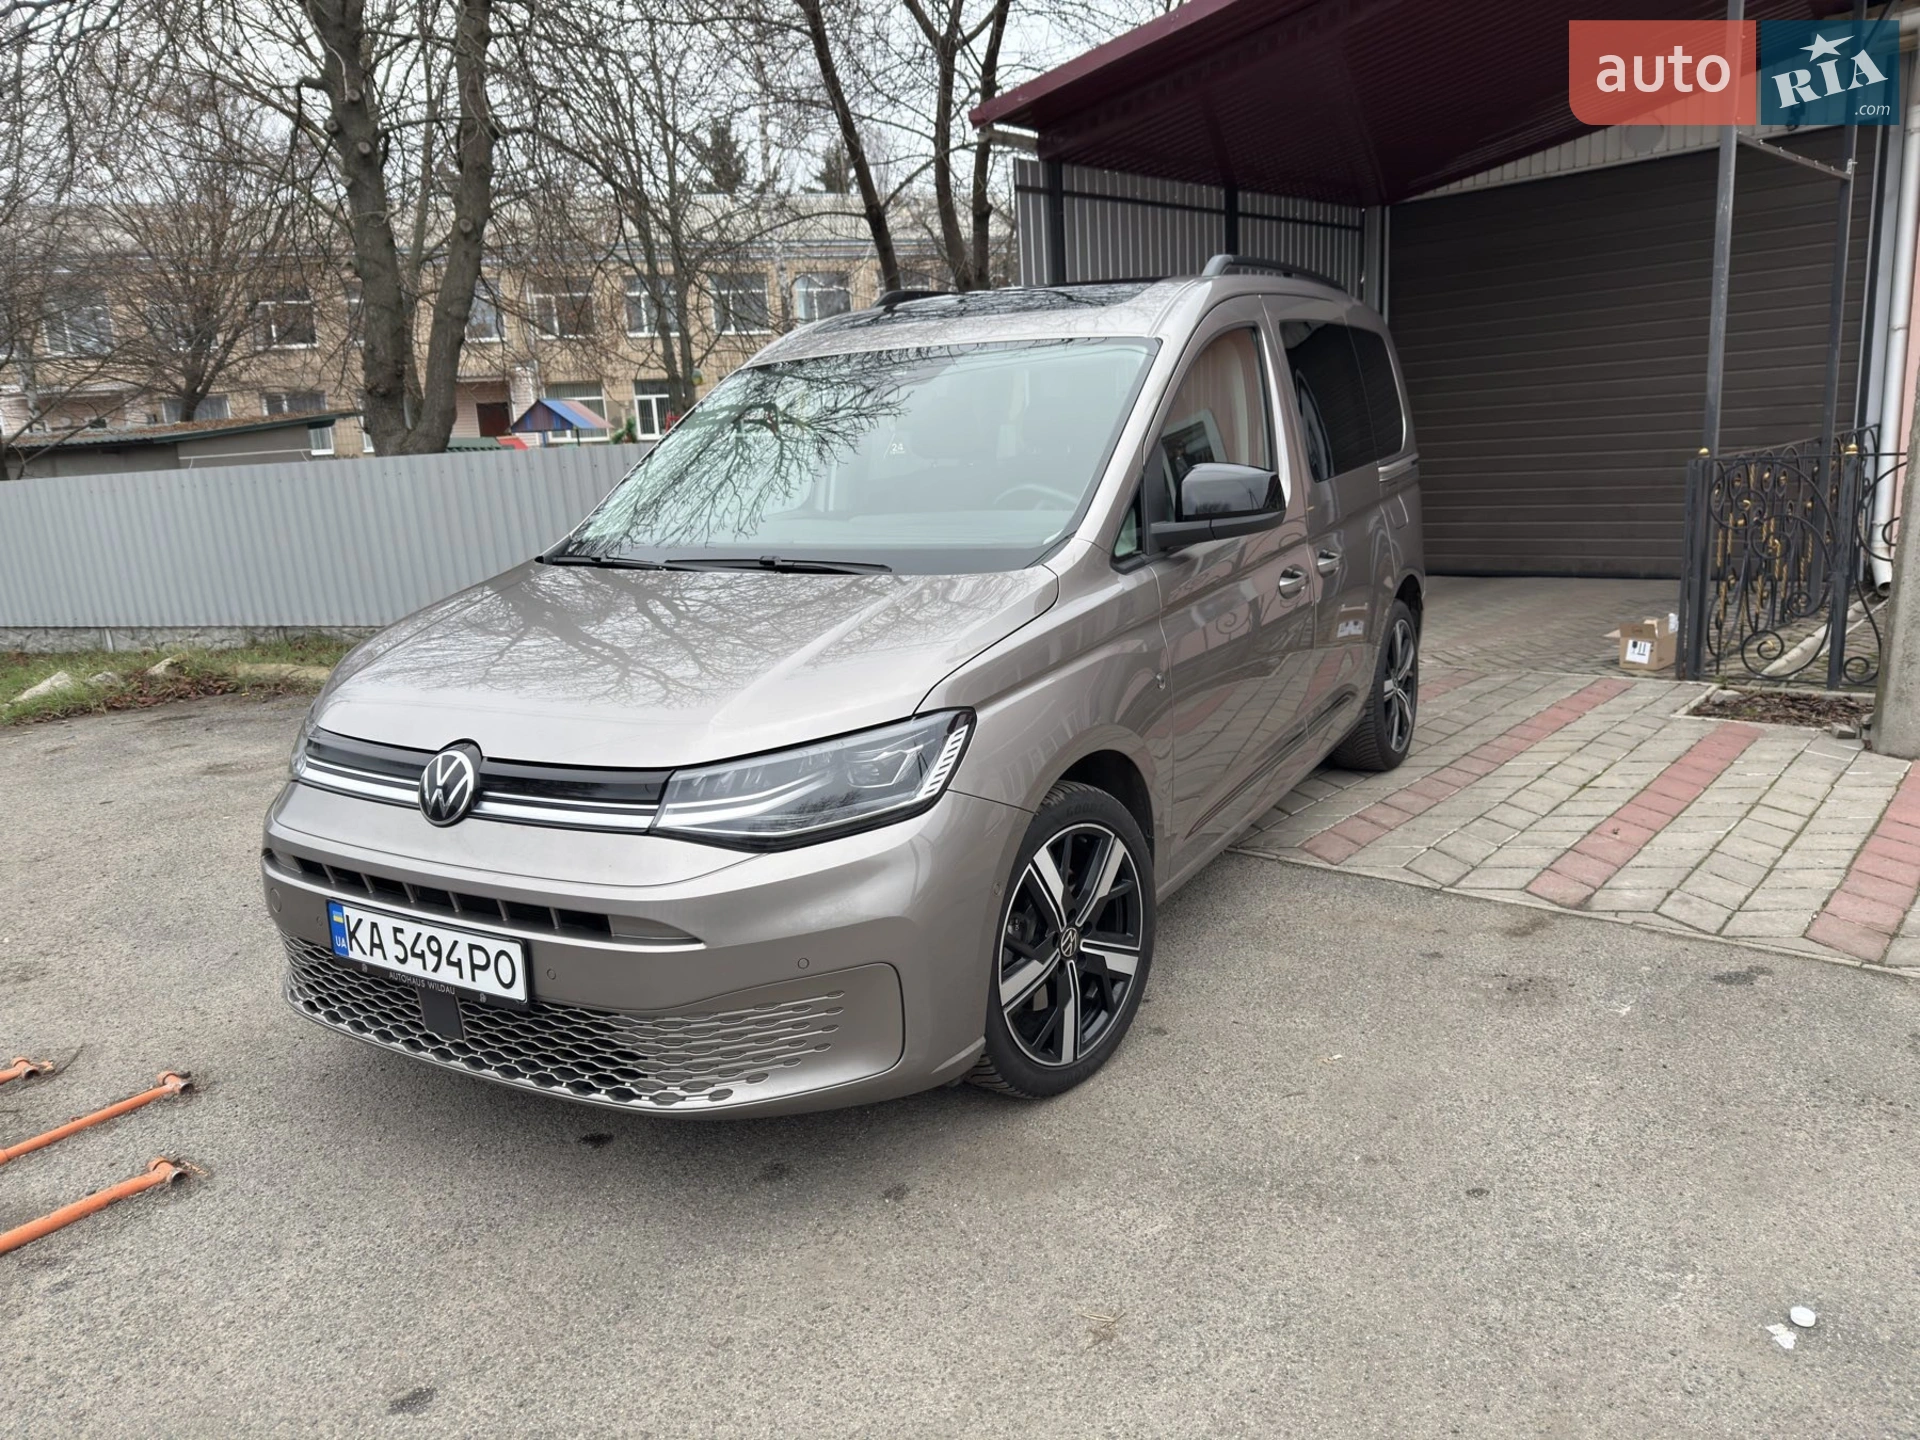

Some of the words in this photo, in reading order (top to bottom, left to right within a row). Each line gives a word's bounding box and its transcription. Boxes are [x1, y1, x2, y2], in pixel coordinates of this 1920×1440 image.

[335, 936, 347, 949] UA
[388, 971, 426, 988] AUTOHAUS
[427, 981, 455, 995] WILDAU
